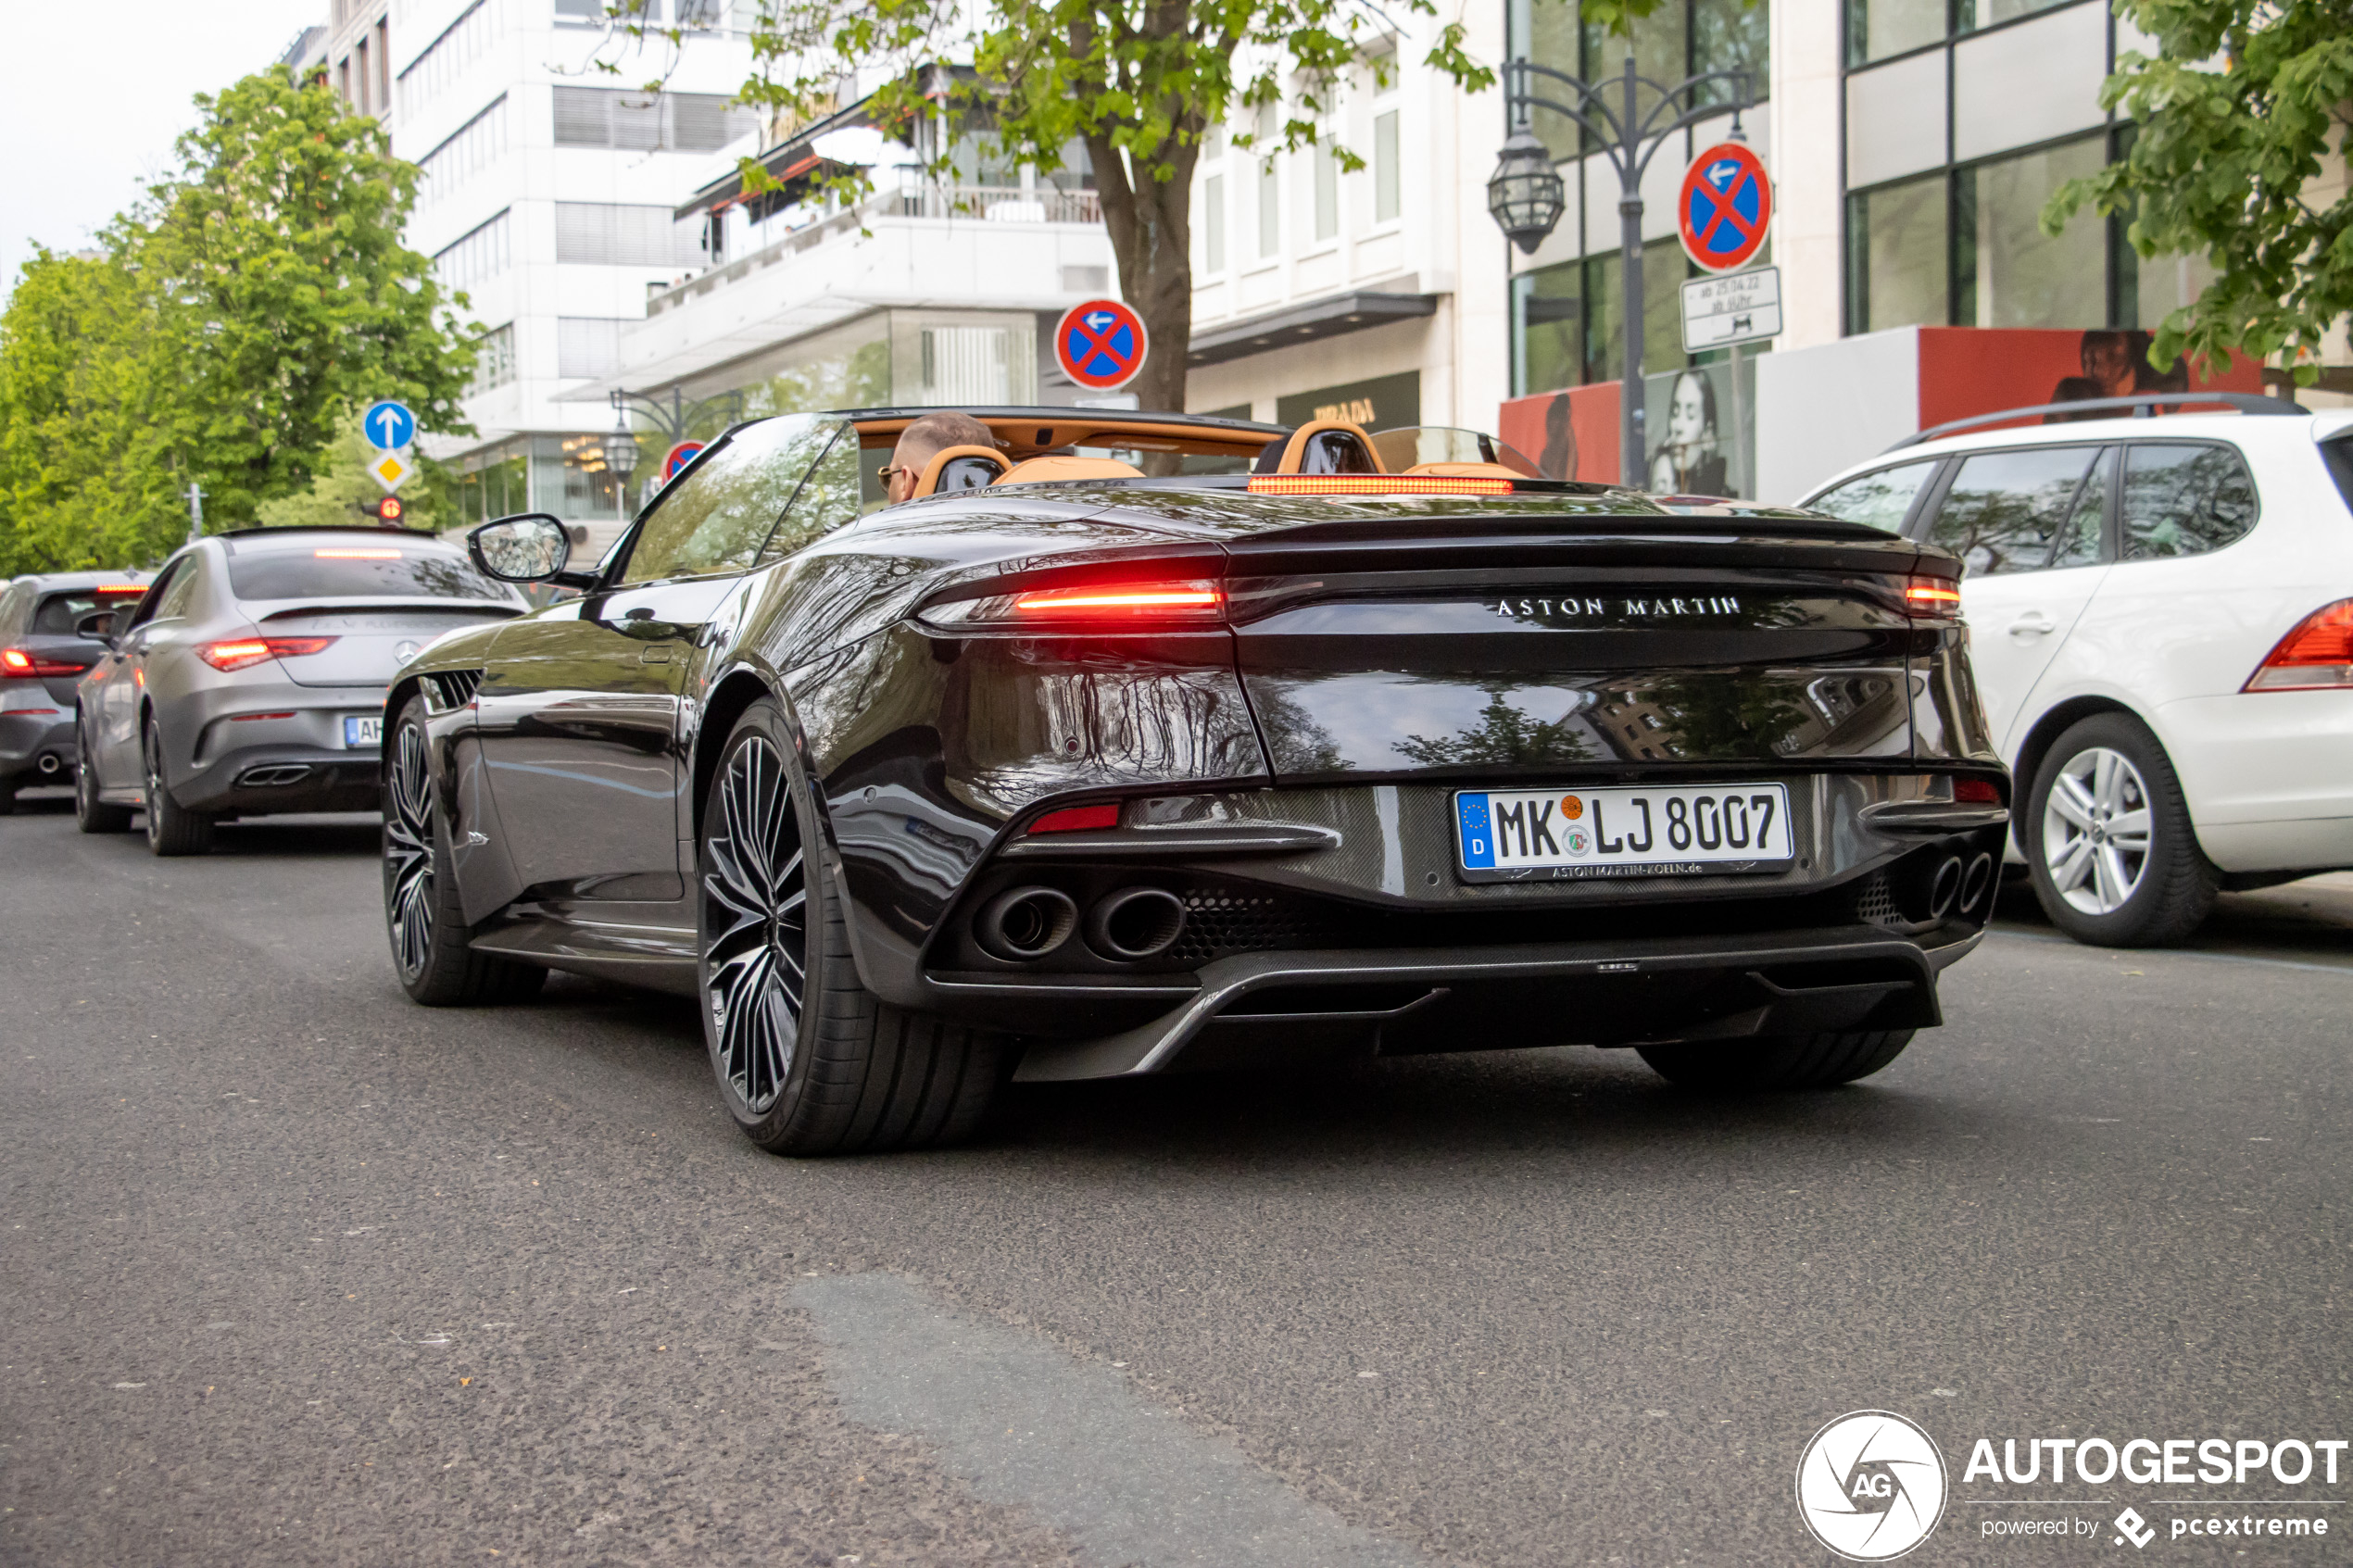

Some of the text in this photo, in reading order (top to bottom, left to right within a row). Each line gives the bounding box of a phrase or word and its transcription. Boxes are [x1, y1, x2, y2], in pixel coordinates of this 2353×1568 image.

[1497, 596, 1741, 617] ASTON MARTIN
[1495, 800, 1560, 858] MK
[1592, 797, 1653, 854] LJ
[1667, 795, 1774, 851] 8007
[1473, 838, 1484, 855] D
[1553, 862, 1703, 878] ASTON MARTIN-KOELN.de
